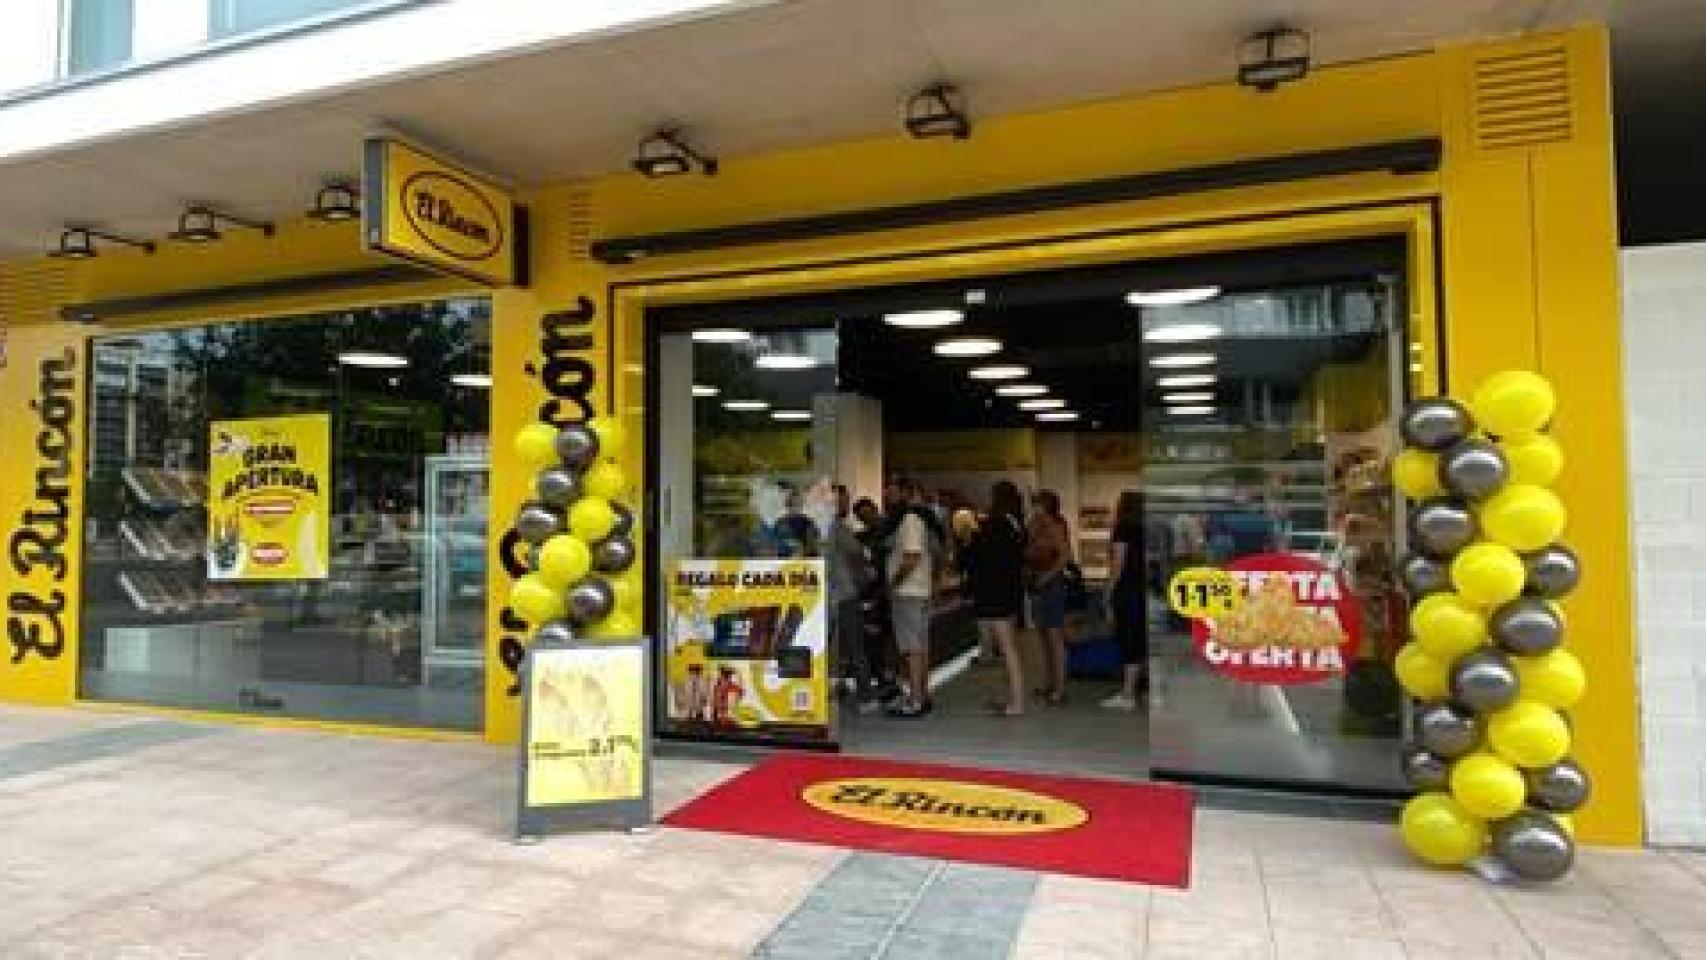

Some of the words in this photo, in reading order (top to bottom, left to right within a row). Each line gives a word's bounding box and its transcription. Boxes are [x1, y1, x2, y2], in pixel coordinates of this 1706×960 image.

[10, 346, 76, 581] Rincón
[243, 442, 297, 467] GRAN
[221, 467, 319, 499] APERTURA
[741, 570, 787, 589] CADA
[7, 590, 67, 664] El
[830, 785, 889, 804] El
